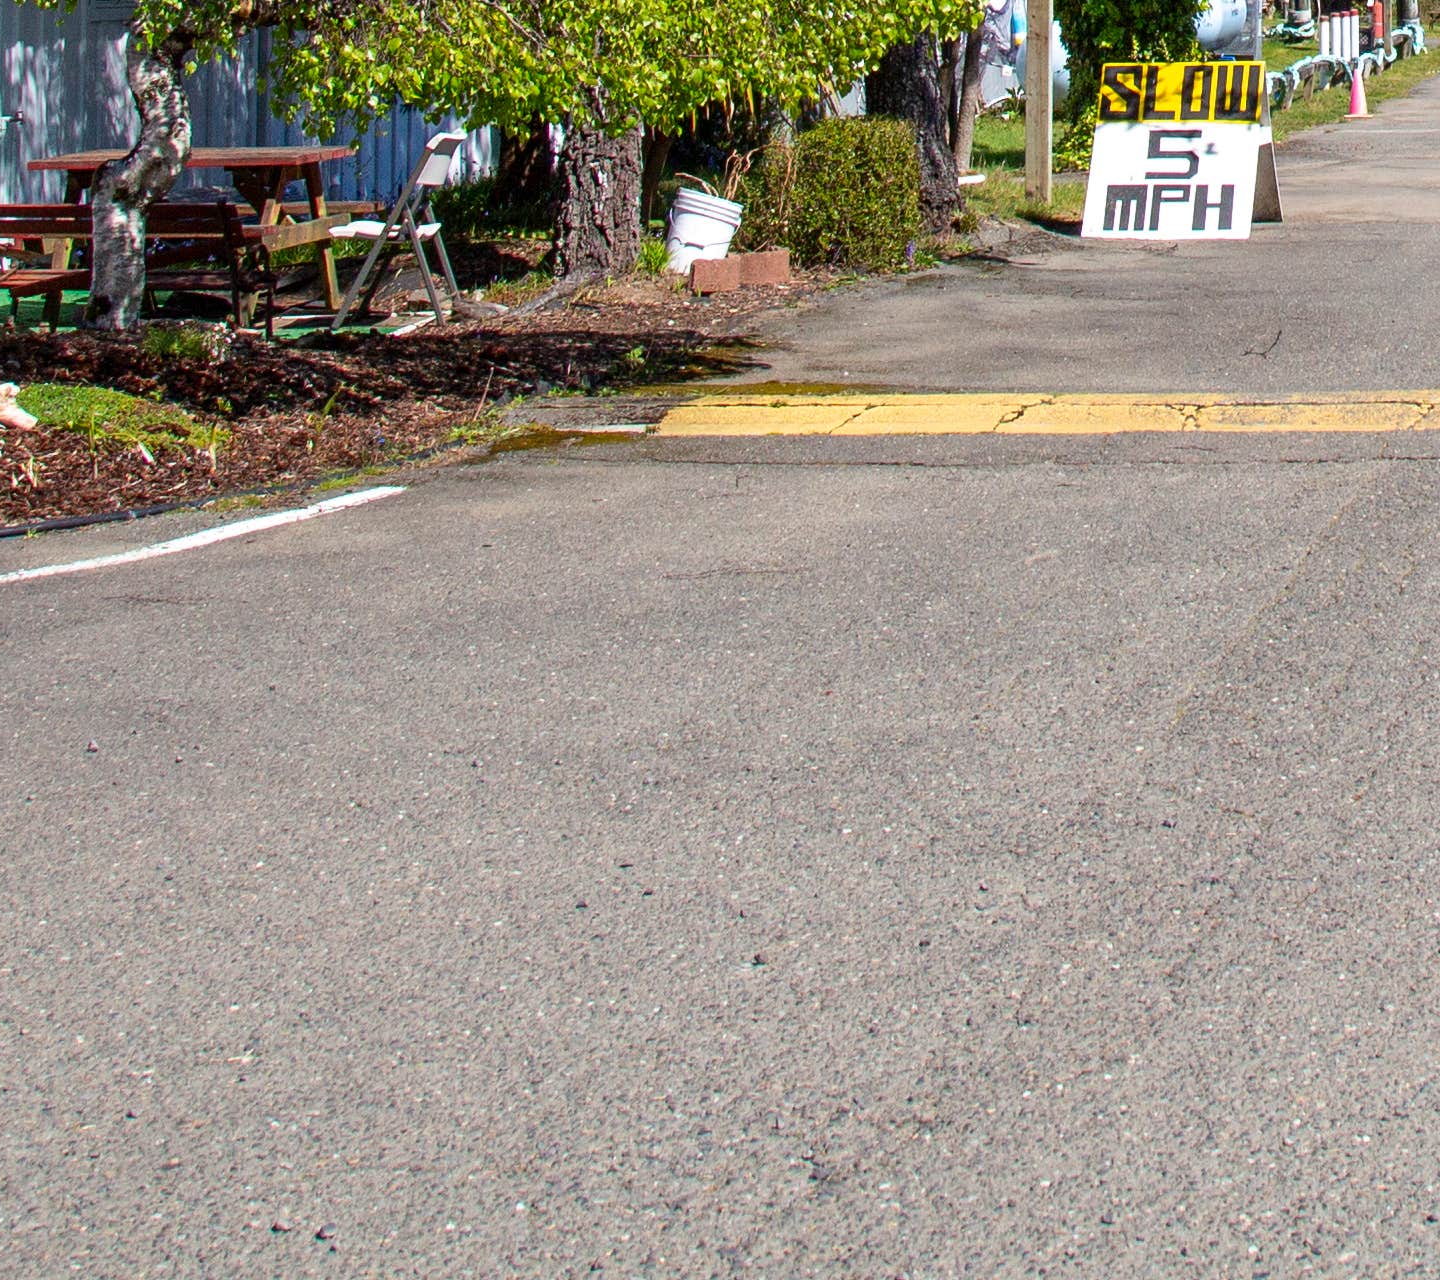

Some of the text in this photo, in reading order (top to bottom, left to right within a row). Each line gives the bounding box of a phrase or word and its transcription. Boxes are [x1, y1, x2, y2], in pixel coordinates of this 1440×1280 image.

[1100, 65, 1261, 120] SLOW
[1145, 130, 1202, 179] 5
[1103, 184, 1234, 231] MPH
